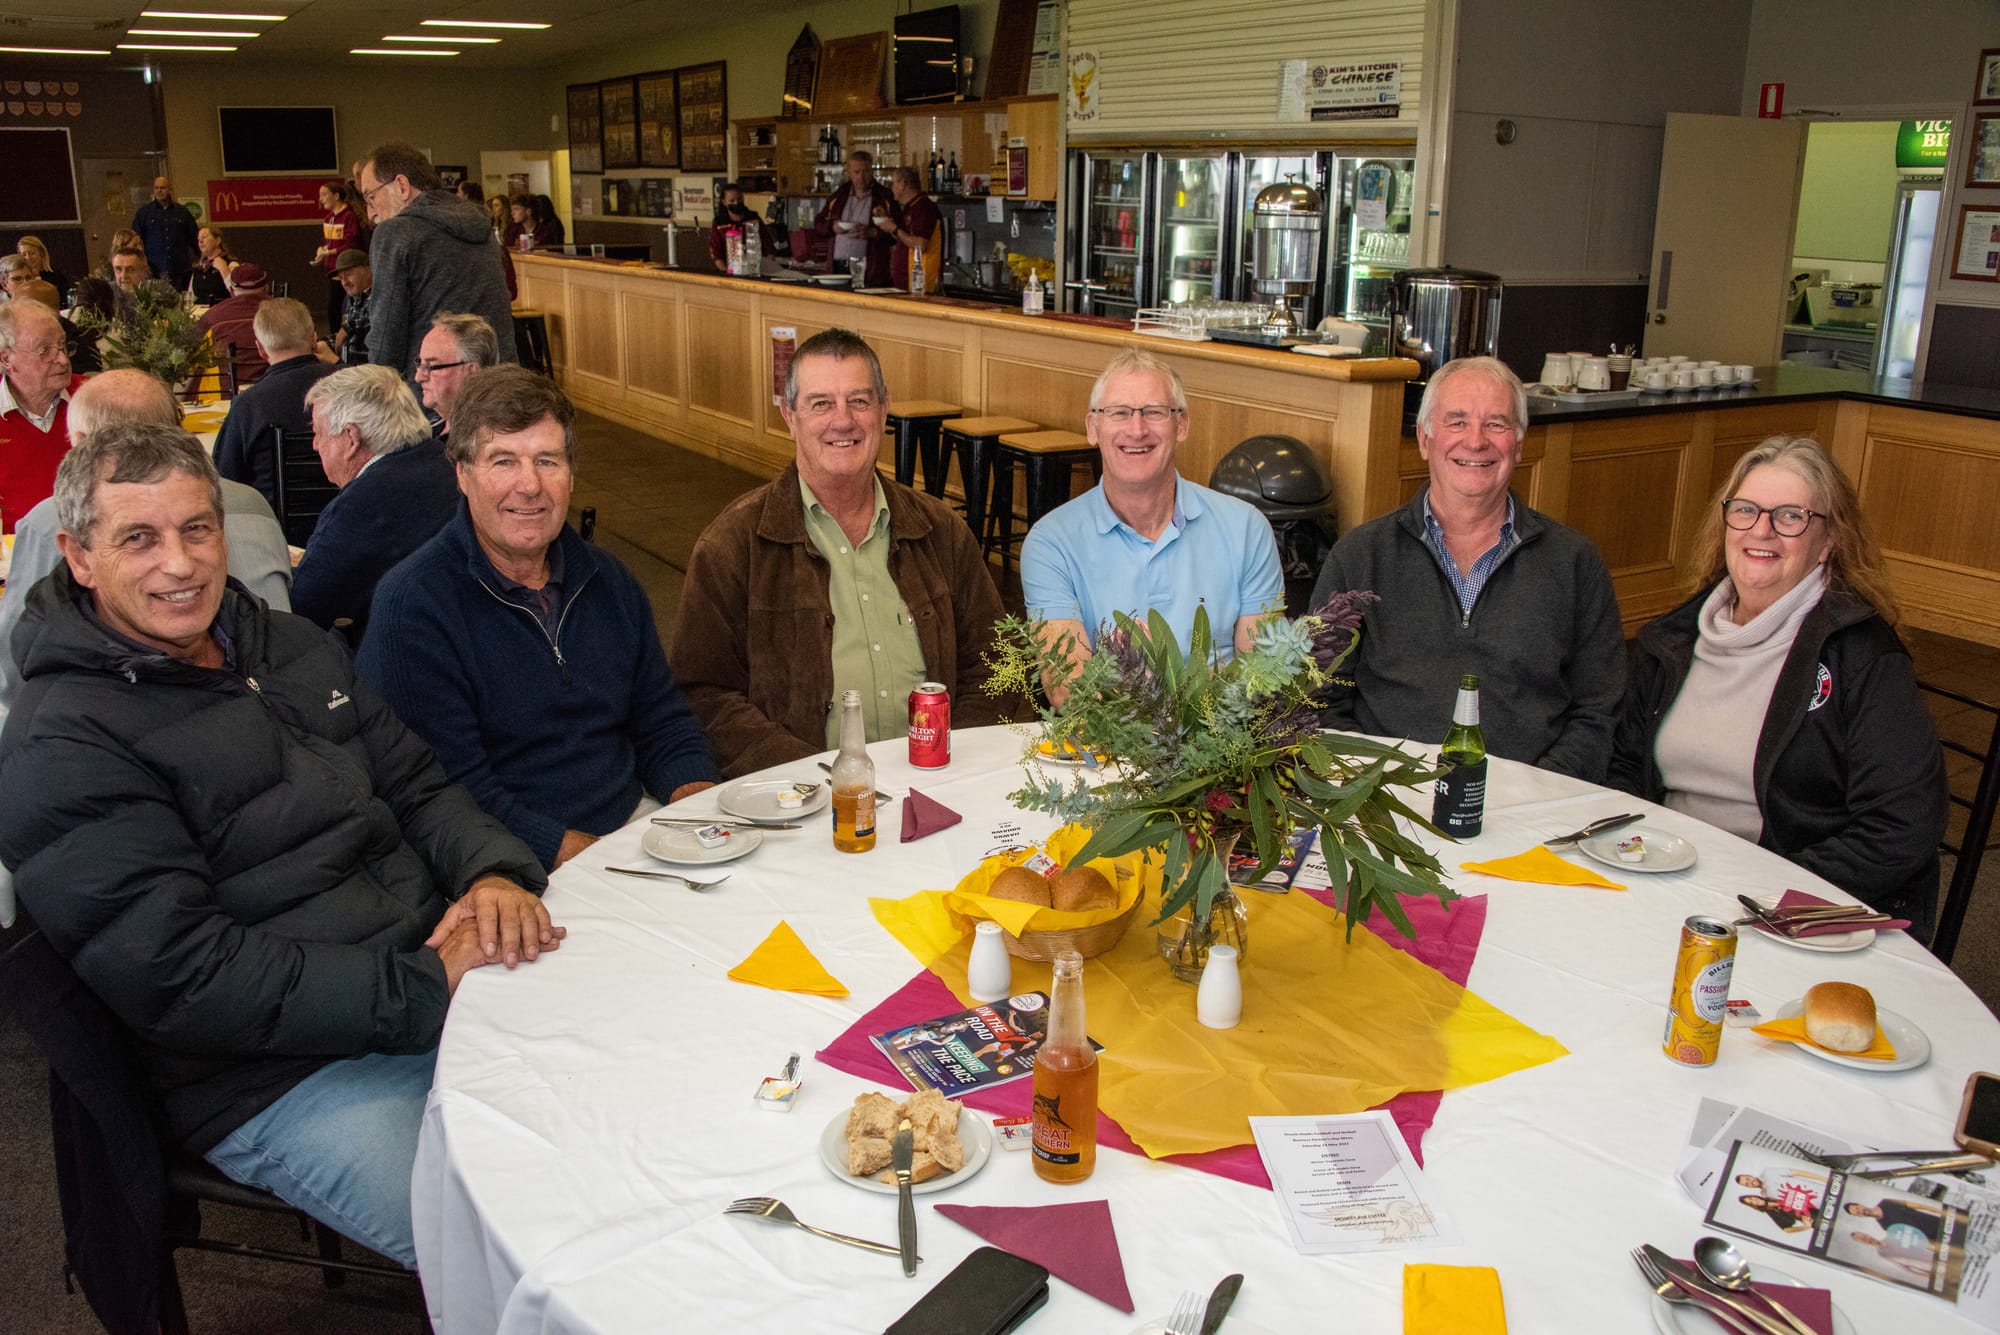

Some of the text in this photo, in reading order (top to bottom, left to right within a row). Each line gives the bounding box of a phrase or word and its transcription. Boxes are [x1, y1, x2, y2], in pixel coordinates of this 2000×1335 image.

[1330, 63, 1398, 73] KIM'S KITCHEN
[1331, 71, 1394, 84] CHINESE
[1700, 984, 1729, 993] PASSION
[965, 1016, 993, 1041] ROAD
[975, 1006, 1009, 1034] ON THE
[932, 1048, 954, 1066] THE
[949, 1062, 976, 1084] PACE
[946, 1041, 985, 1072] KEEPING
[1033, 1120, 1071, 1140] REAT
